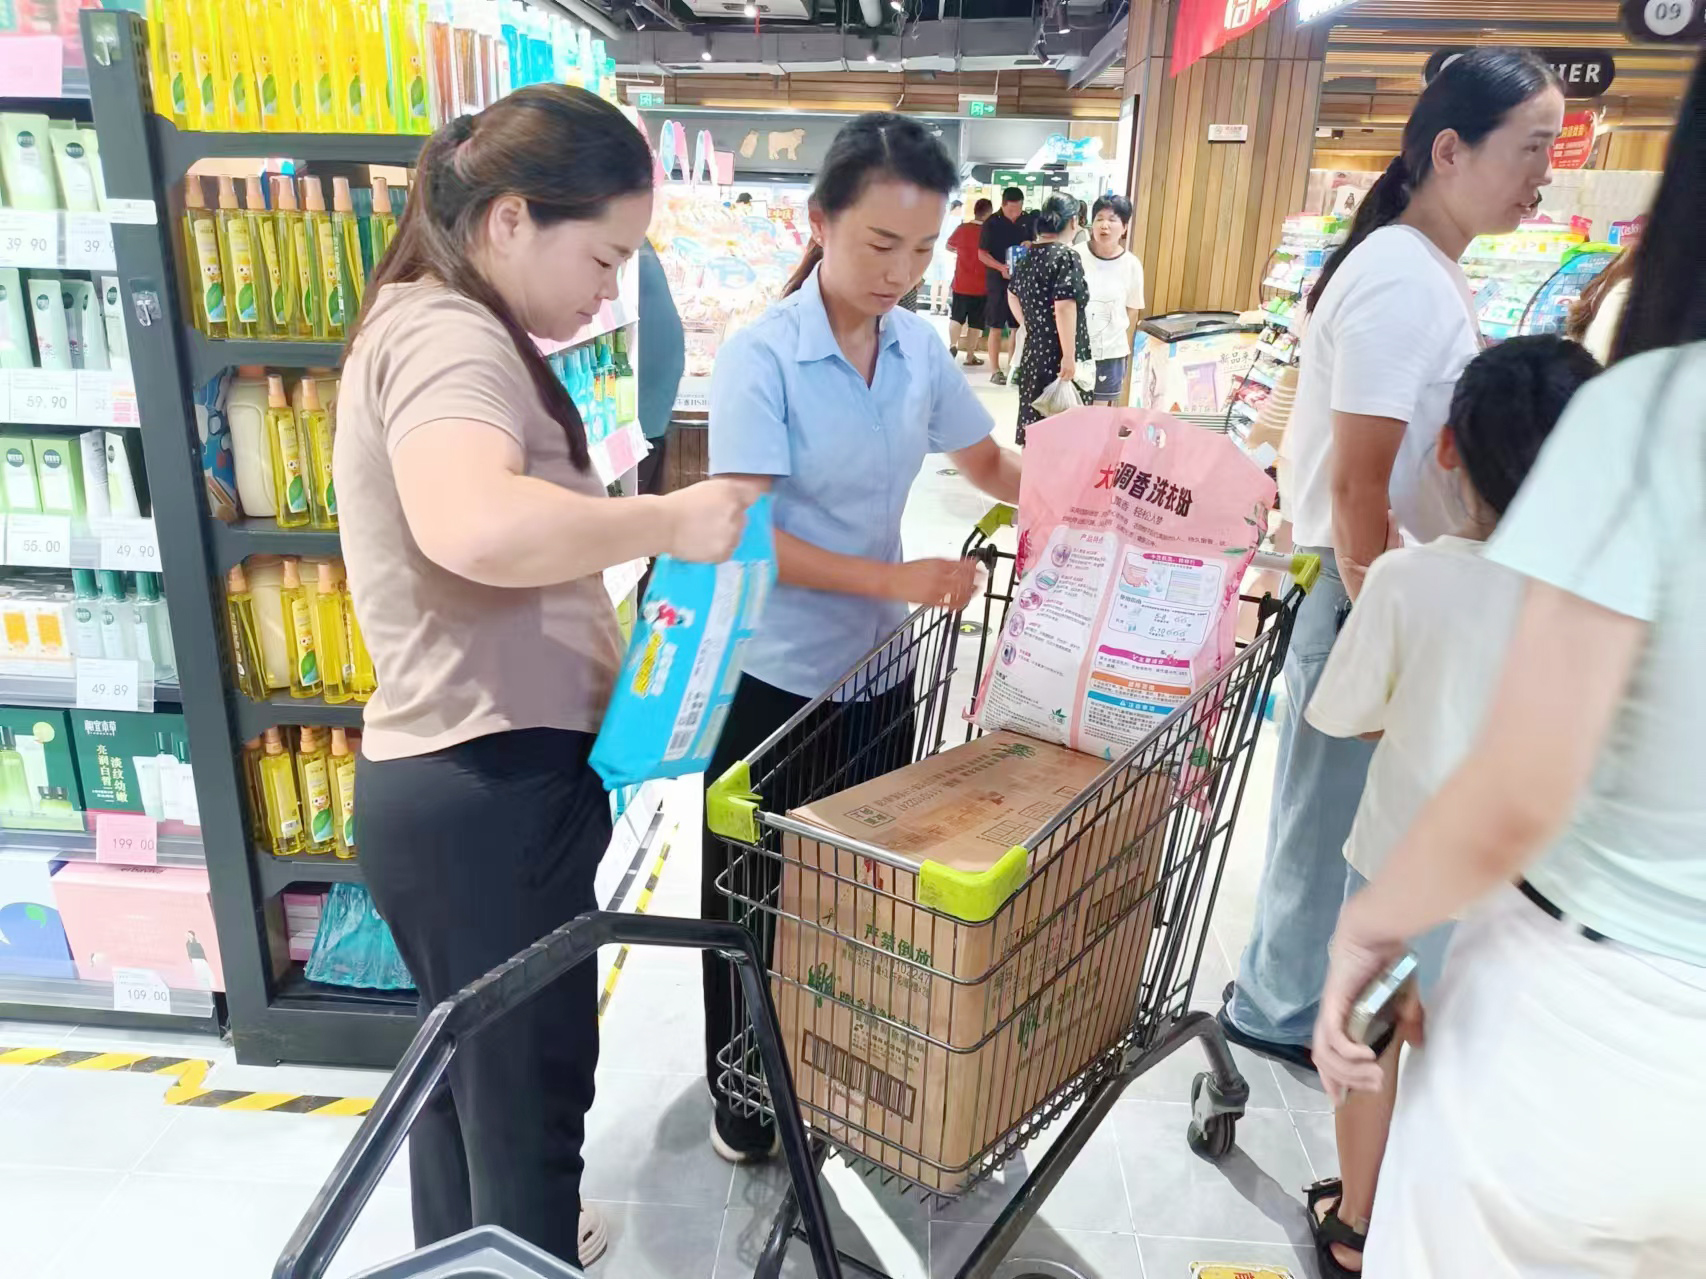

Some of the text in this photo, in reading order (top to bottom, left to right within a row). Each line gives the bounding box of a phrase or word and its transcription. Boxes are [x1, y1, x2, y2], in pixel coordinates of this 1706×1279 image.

[1655, 3, 1682, 21] 09
[26, 395, 67, 409] 59.90
[23, 539, 61, 553] 55.00
[116, 544, 155, 558] 49.90
[91, 683, 129, 696] 49.89
[112, 838, 155, 850] 199.00
[864, 923, 931, 966] 严禁倒放
[127, 988, 168, 1002] 109.00
